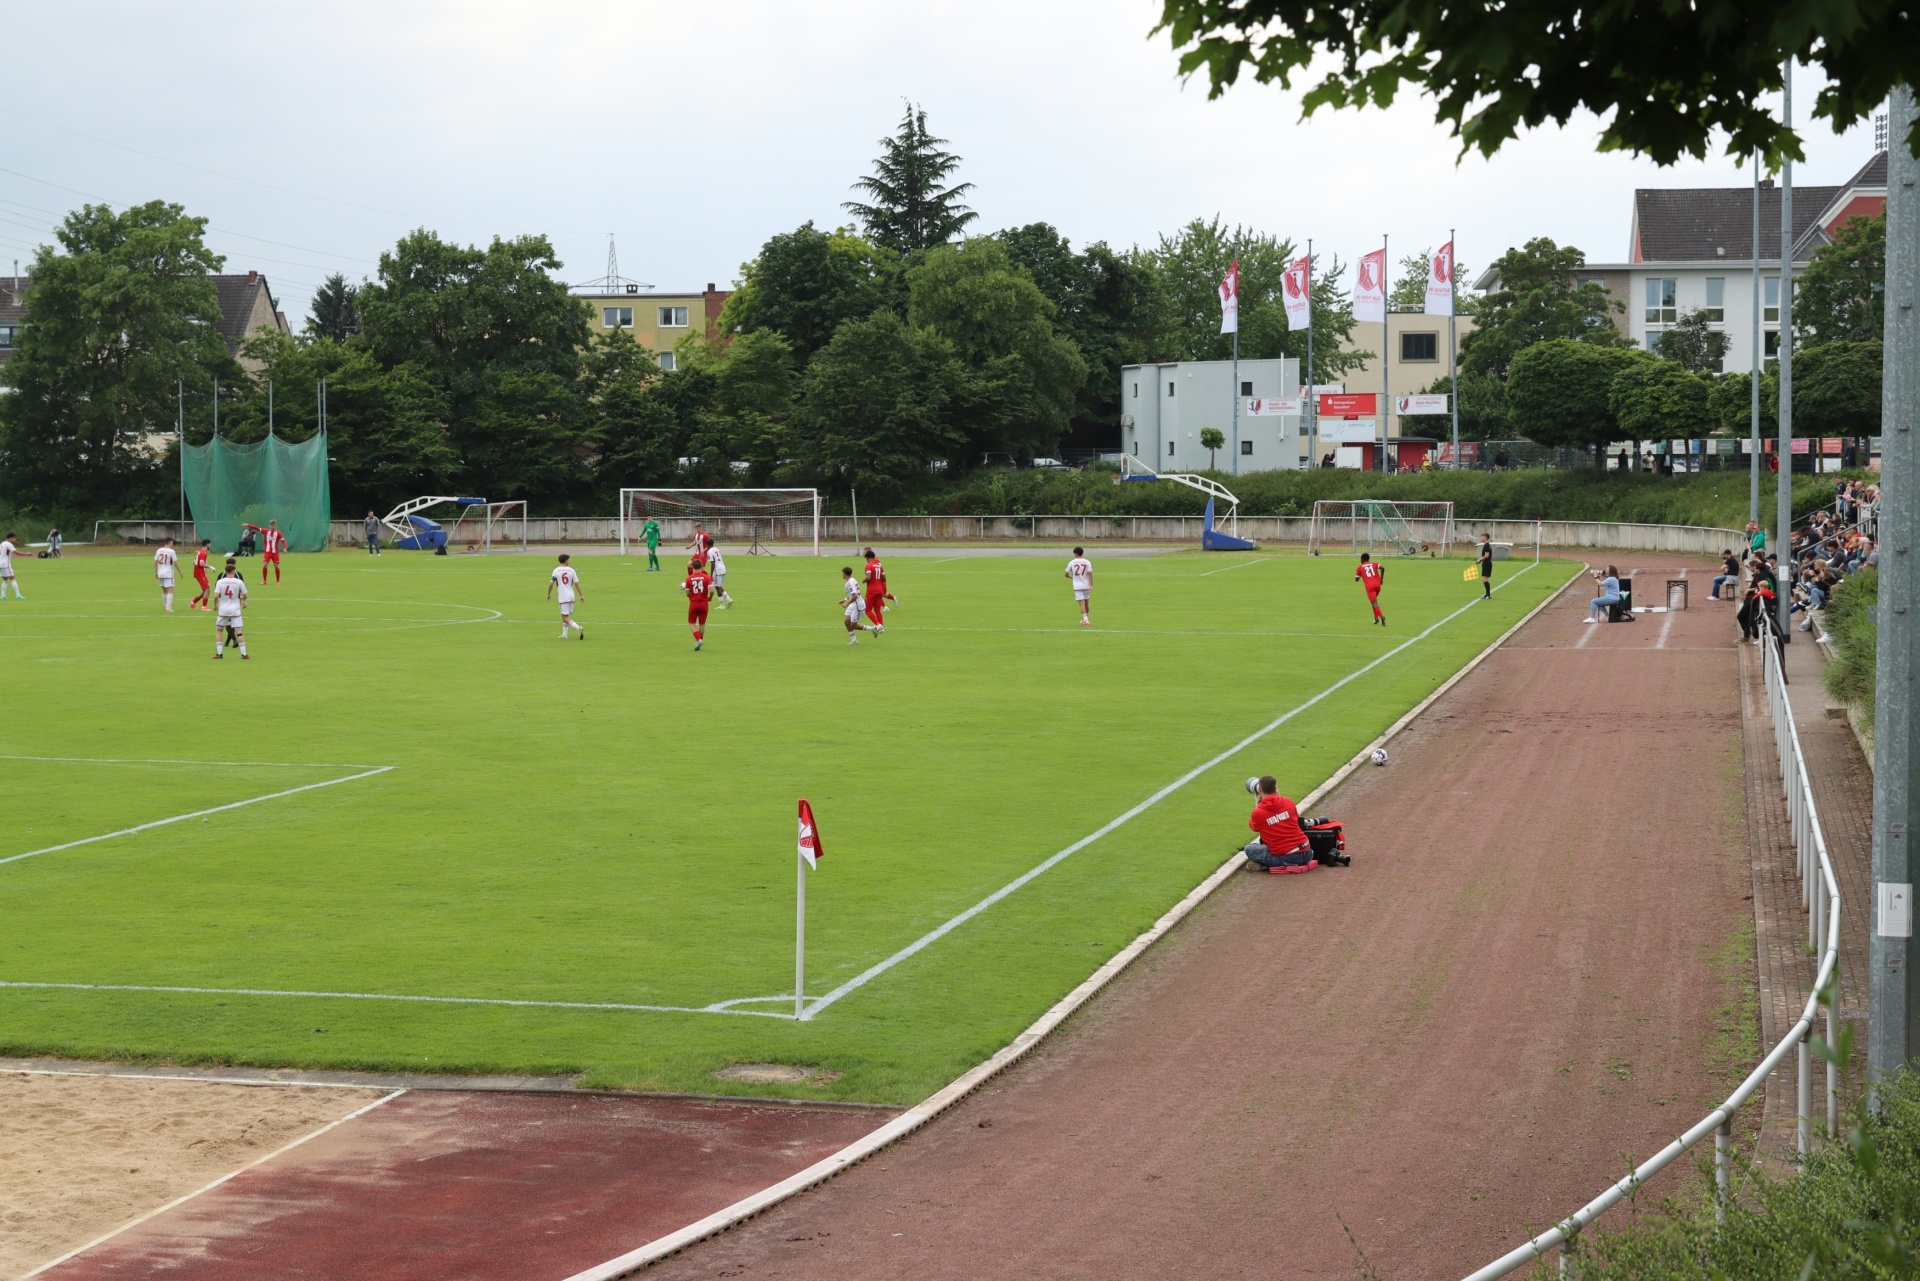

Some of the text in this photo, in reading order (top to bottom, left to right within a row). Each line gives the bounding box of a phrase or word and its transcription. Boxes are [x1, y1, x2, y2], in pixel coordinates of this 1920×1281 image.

[159, 553, 168, 565] 21
[875, 567, 881, 580] 11
[1074, 564, 1087, 576] 27
[1364, 565, 1375, 577] 21
[562, 572, 569, 585] 6
[224, 585, 233, 599] 4
[692, 580, 704, 594] 24
[1266, 810, 1290, 826] FOTO/VIDEO
